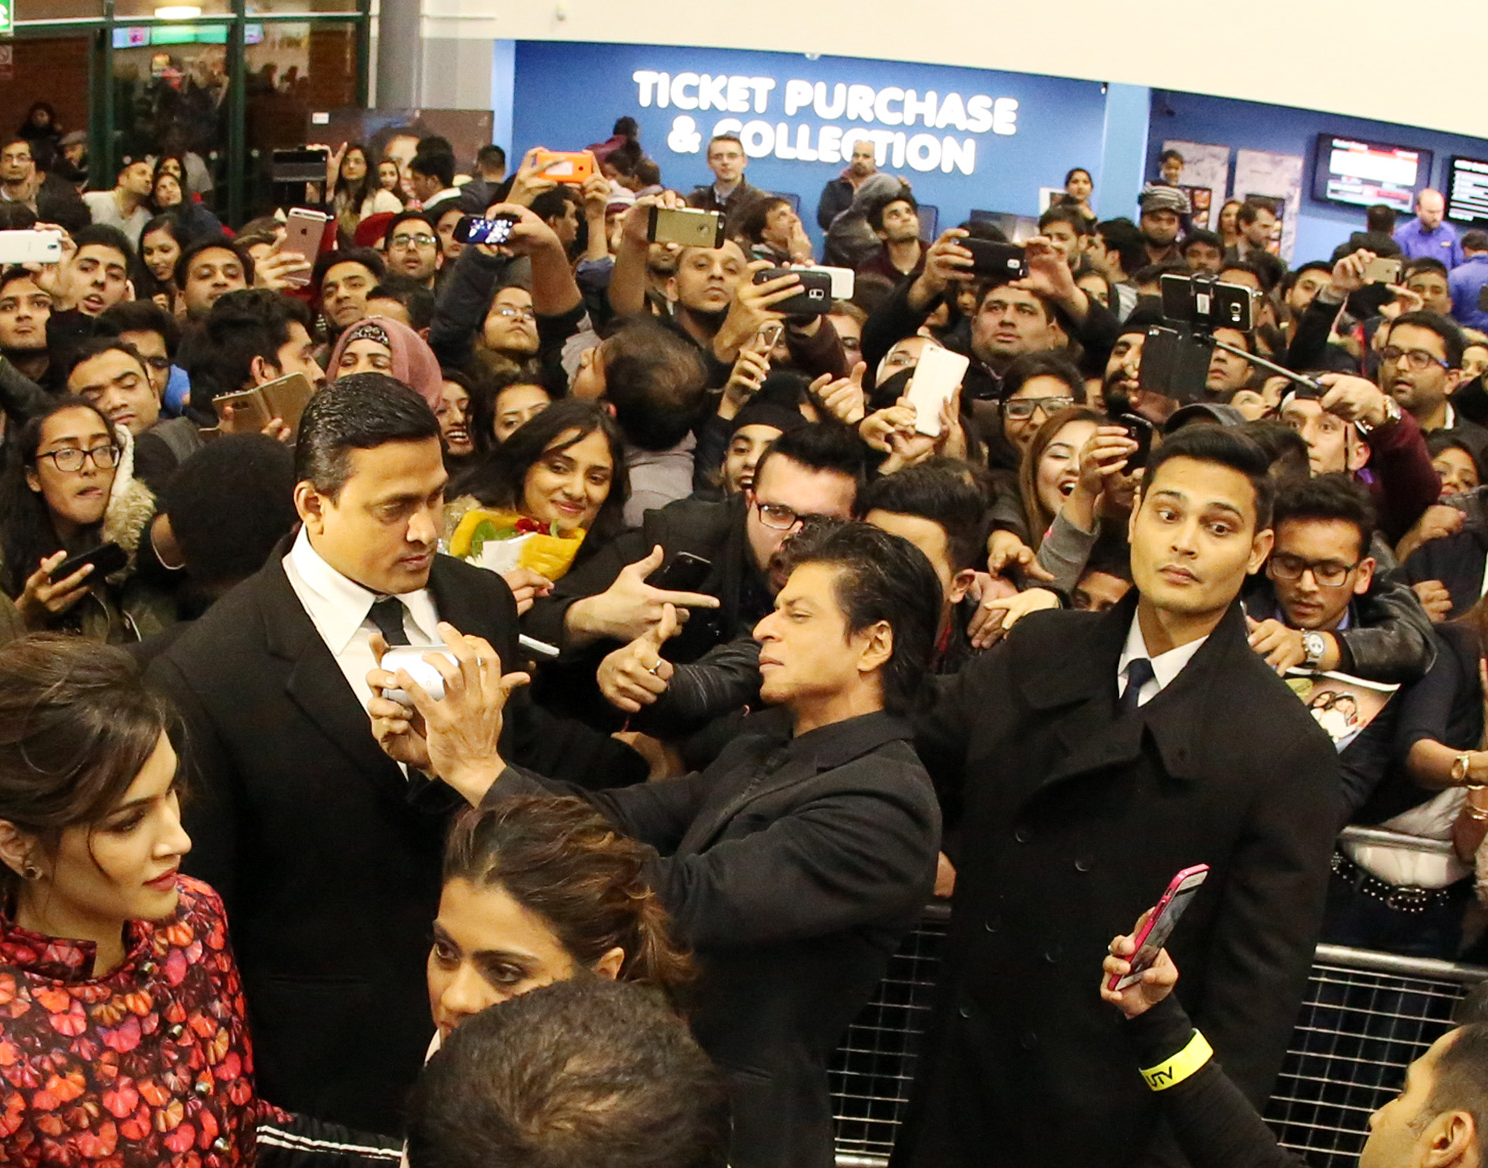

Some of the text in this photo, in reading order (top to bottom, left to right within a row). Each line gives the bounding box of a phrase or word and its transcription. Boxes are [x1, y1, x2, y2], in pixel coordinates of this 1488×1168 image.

[632, 69, 1019, 136] TICKET PURCHASE
[667, 115, 702, 154] &
